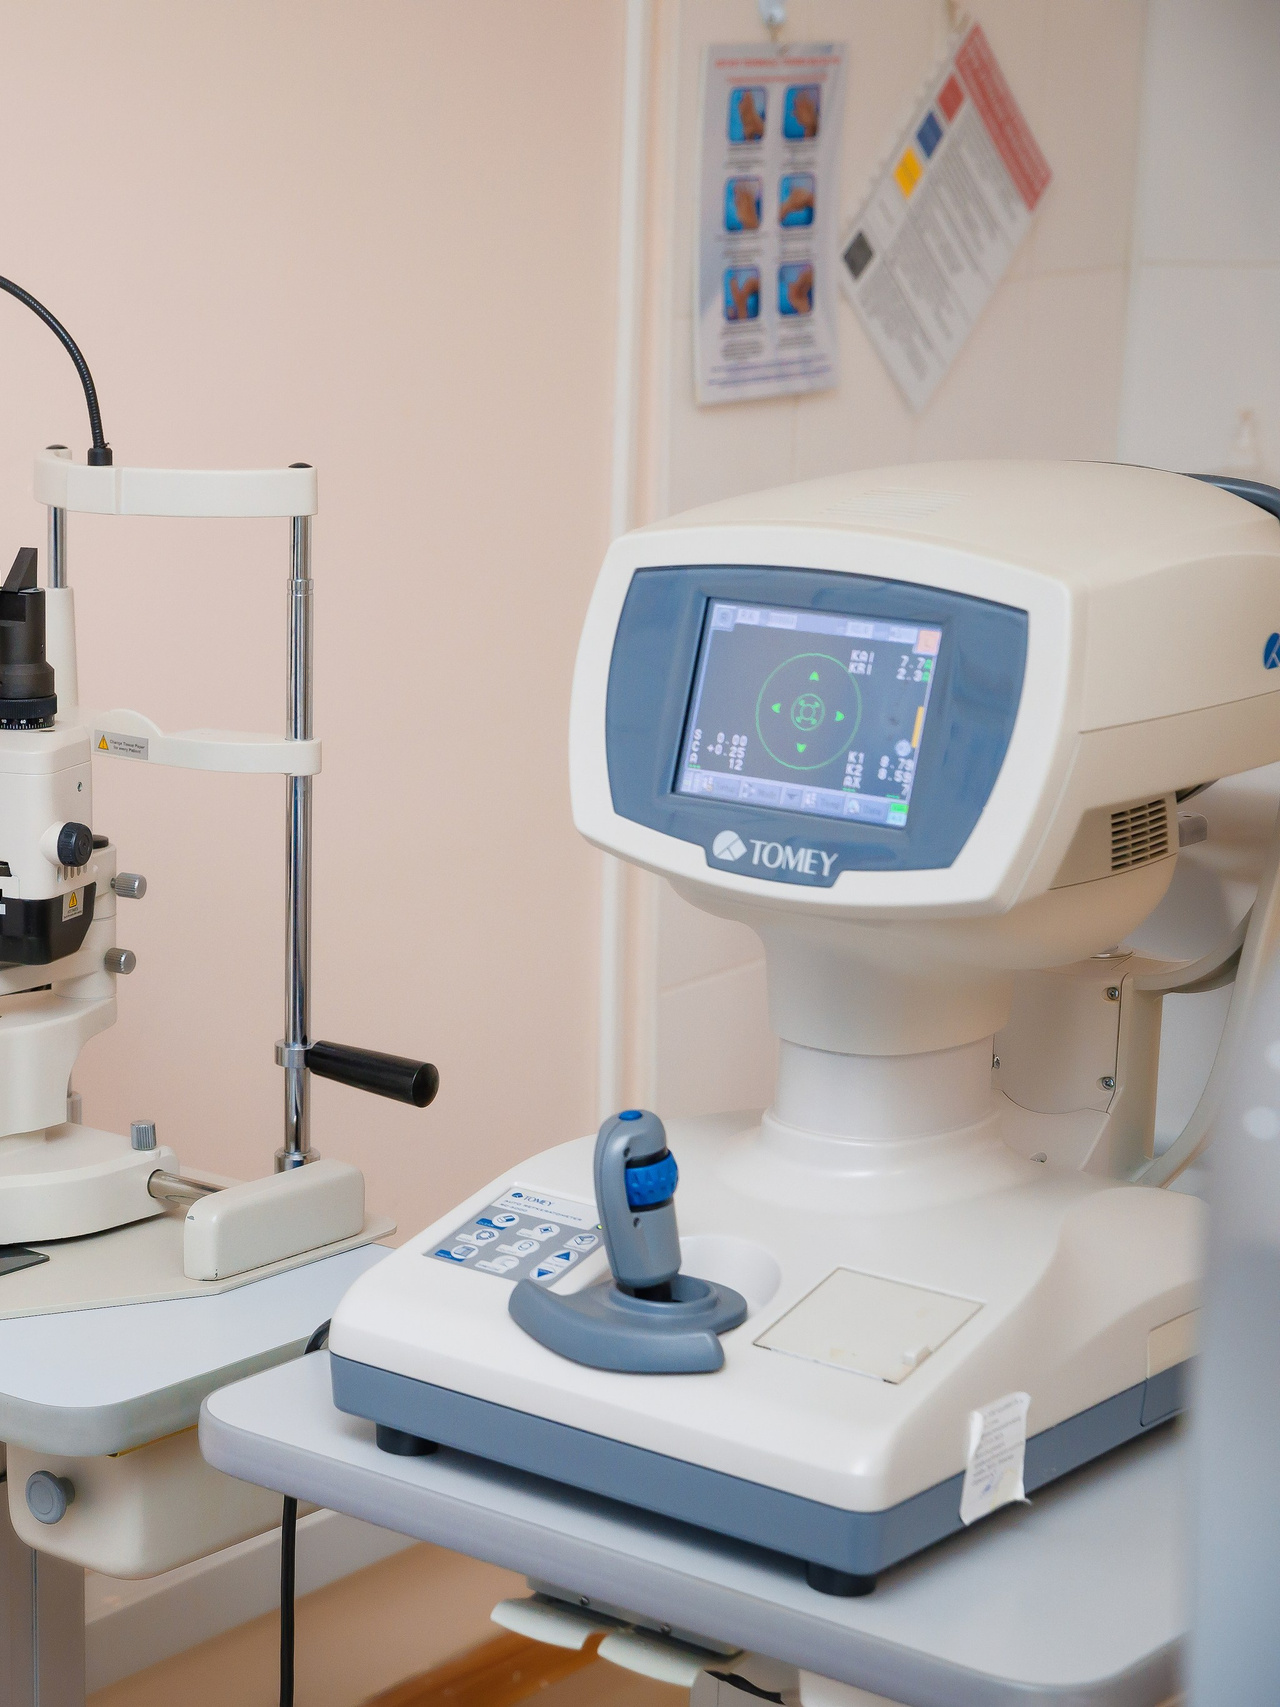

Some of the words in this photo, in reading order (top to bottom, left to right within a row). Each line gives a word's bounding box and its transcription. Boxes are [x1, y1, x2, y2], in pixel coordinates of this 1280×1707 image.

[692, 741, 700, 752] C
[729, 758, 743, 770] 12
[749, 839, 838, 877] TOMEY
[524, 1195, 554, 1206] TOMEY
